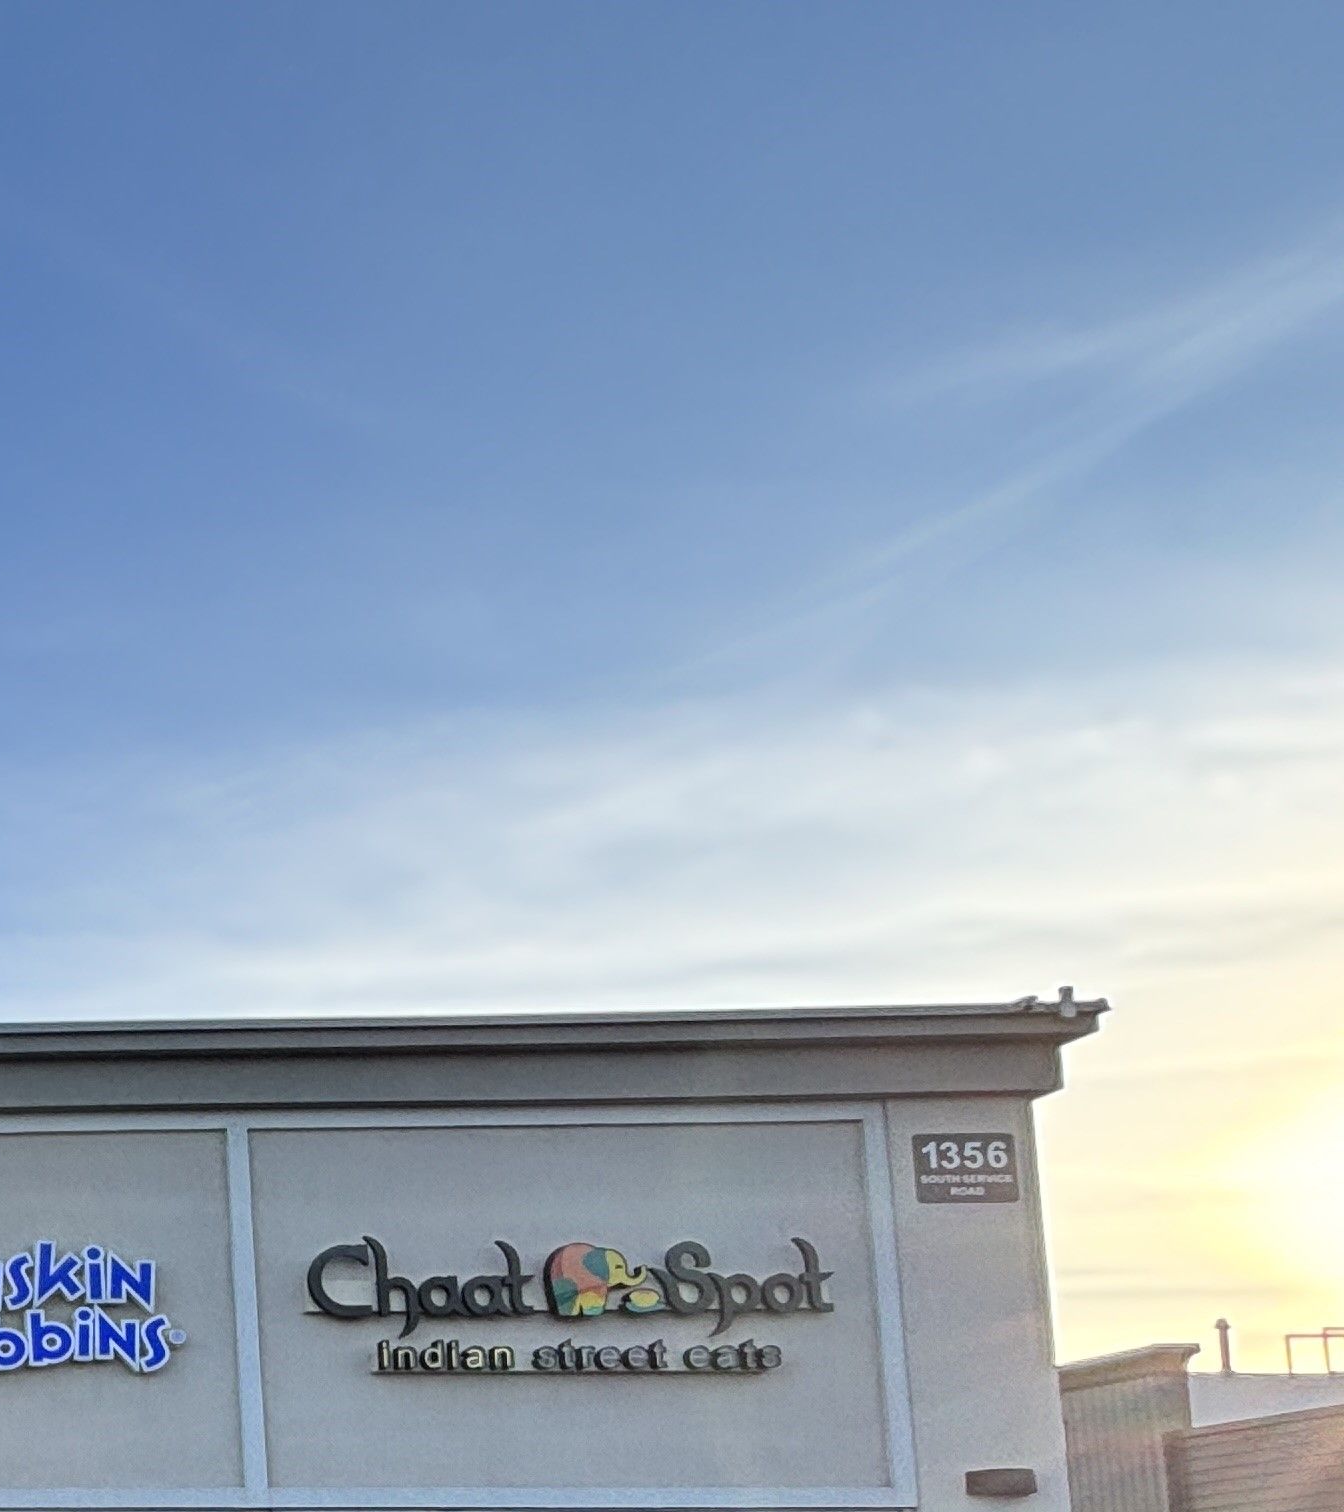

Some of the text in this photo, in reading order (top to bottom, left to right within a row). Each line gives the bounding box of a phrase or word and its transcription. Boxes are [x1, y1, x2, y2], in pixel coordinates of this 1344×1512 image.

[921, 1141, 1008, 1169] 1356
[920, 1174, 1012, 1184] SOUTH SERVICE
[950, 1186, 985, 1195] ROAD
[307, 1236, 835, 1339] Chaat Spot
[375, 1338, 783, 1371] indian street eats
